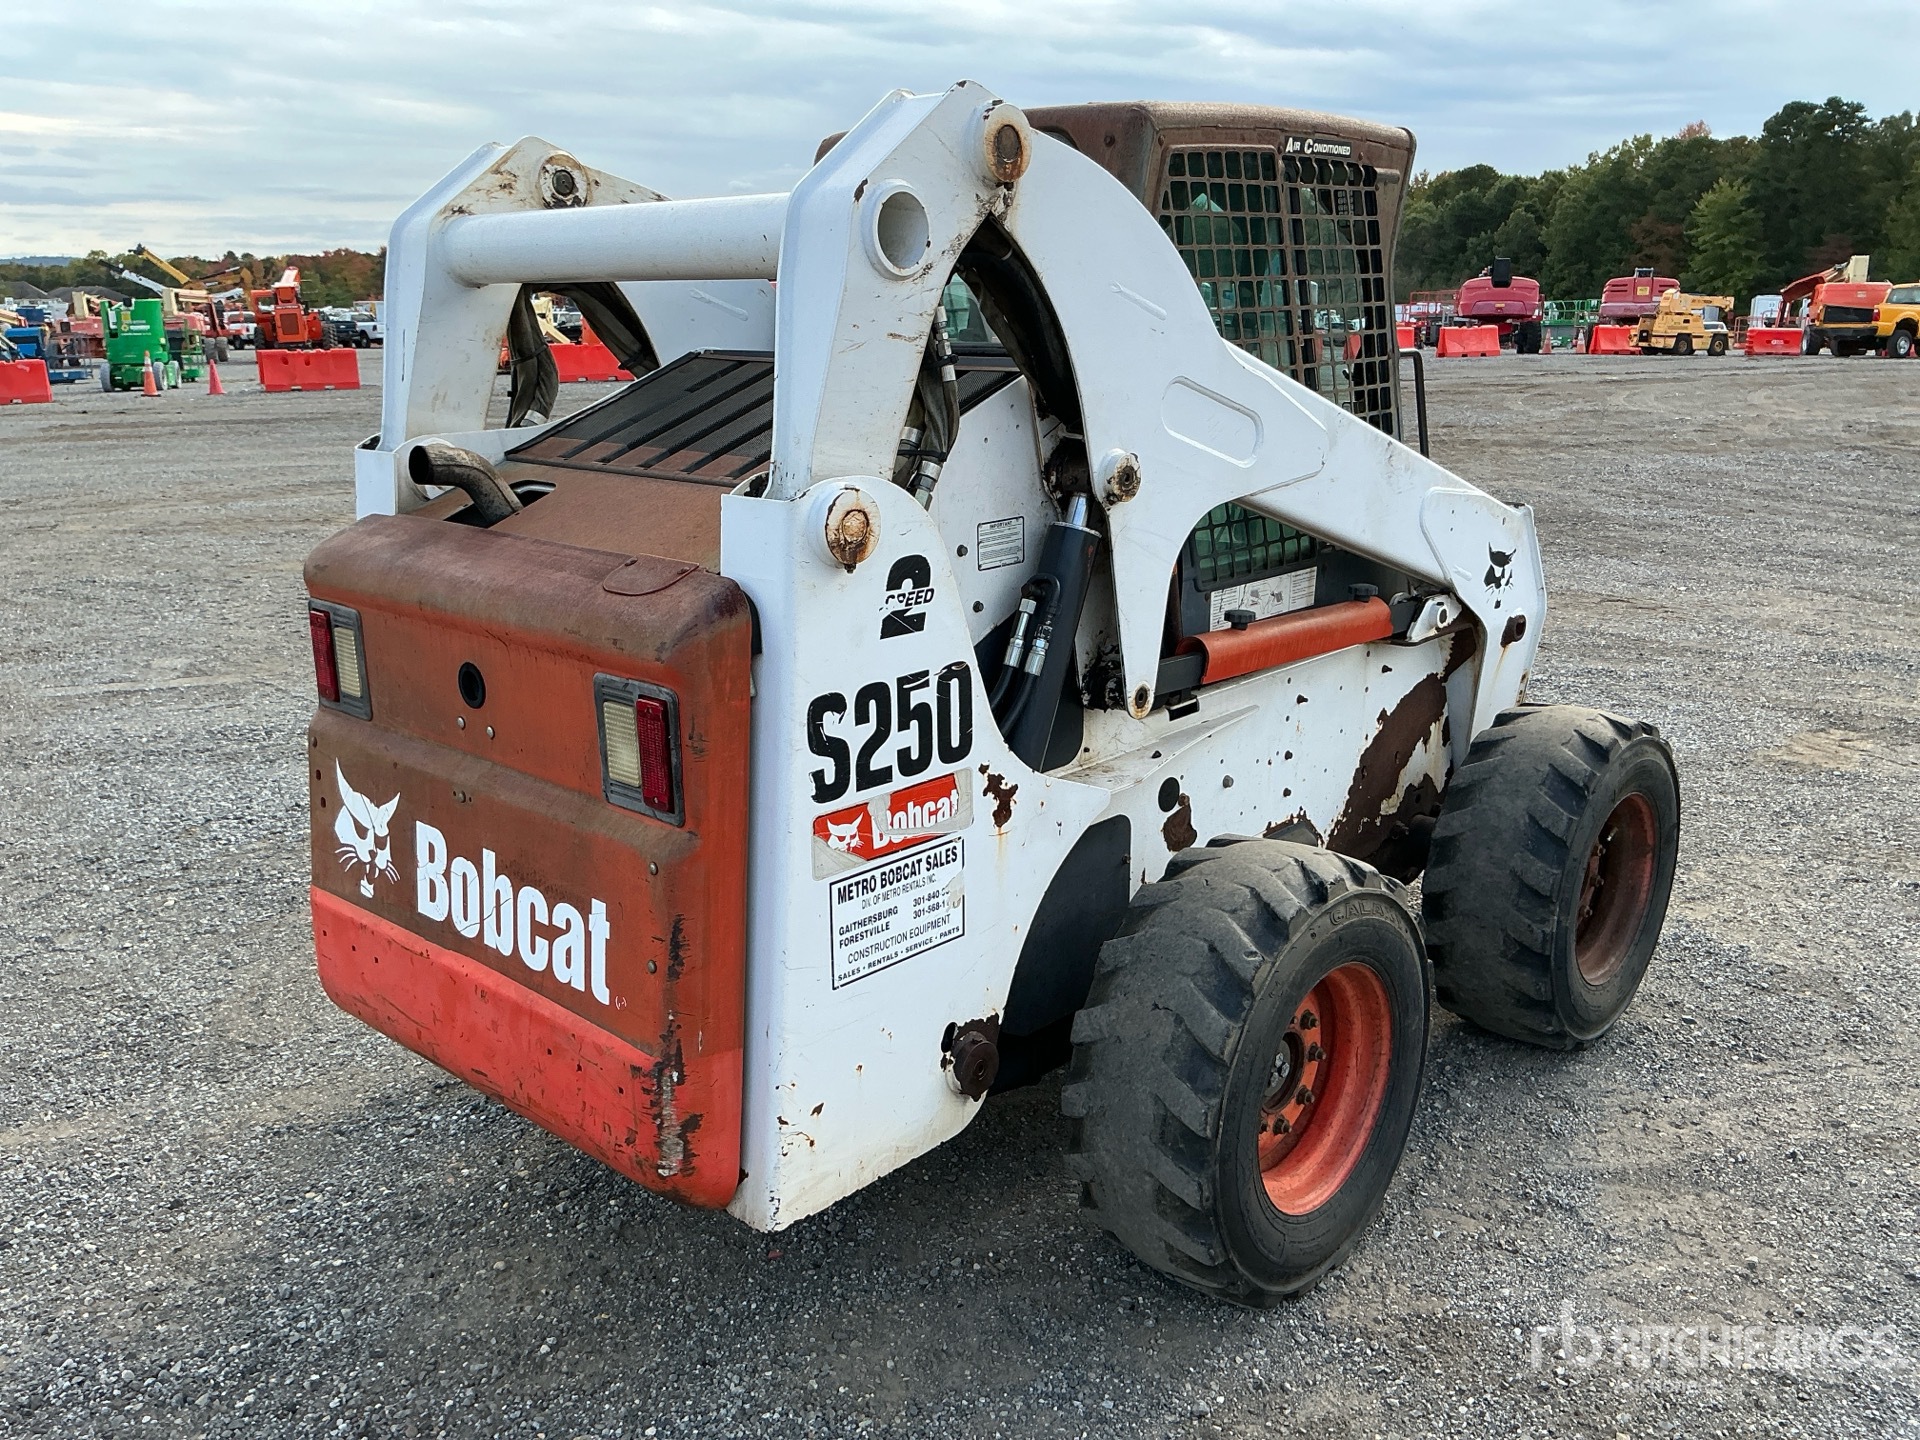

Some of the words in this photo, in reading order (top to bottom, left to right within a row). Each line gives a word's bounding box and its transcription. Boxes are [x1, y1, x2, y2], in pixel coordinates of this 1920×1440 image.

[1304, 138, 1351, 155] CONDITIONED
[880, 554, 931, 640] 2
[807, 661, 973, 804] S250
[837, 874, 877, 905] METRO
[880, 858, 923, 889] BOBCAT
[926, 846, 958, 872] SALES
[873, 893, 881, 906] OF
[882, 887, 901, 902] METRO
[902, 876, 926, 894] RENTALS
[415, 820, 610, 1006] Bobcat
[838, 905, 899, 936] GAITHERSBURG
[839, 920, 891, 949] FORESTVILLE
[847, 931, 908, 965] CONSTRUCTION
[909, 913, 951, 939] EQUIPMENT
[837, 966, 861, 982] SALES
[867, 951, 899, 969] RENTALS
[905, 936, 934, 954] SERVICE
[939, 925, 960, 940] PARTS
